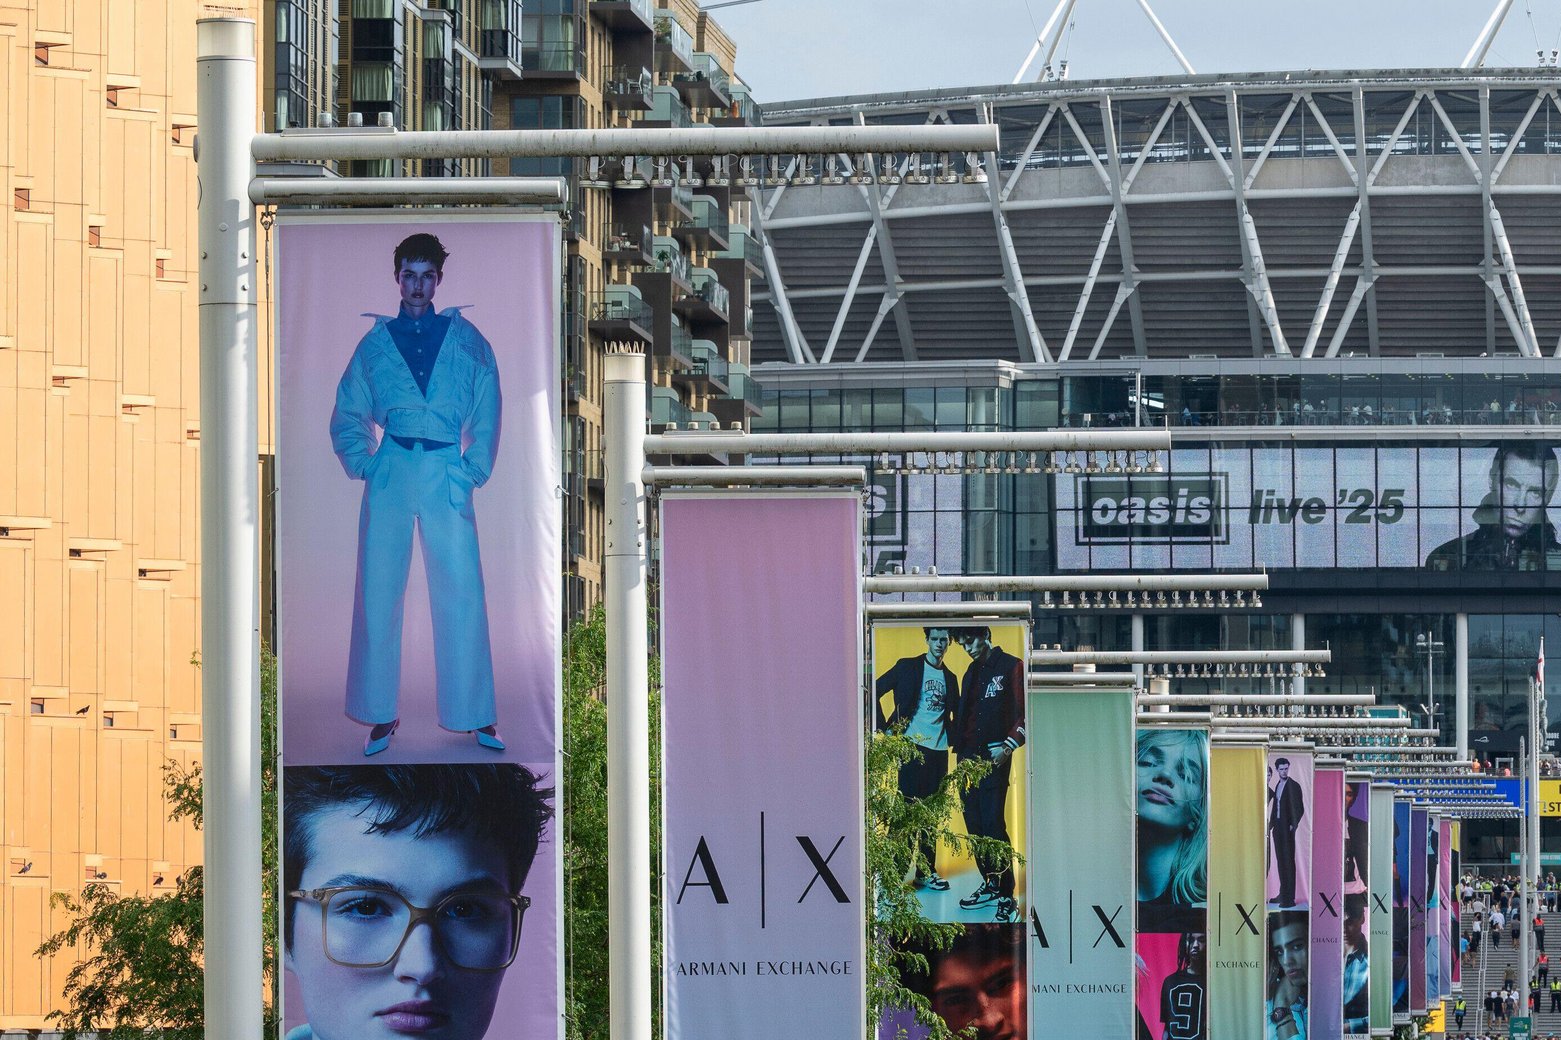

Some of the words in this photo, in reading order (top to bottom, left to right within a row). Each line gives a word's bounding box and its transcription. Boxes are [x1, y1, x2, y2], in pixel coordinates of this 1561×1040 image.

[1091, 488, 1213, 525] oasis
[1248, 489, 1326, 525] live
[677, 961, 746, 976] ARMANI
[756, 960, 853, 976] EXCHANGE
[1215, 961, 1260, 969] EXCHANGE
[1032, 984, 1060, 993] MANI
[1066, 984, 1127, 994] EXCHANGE
[1168, 983, 1203, 1040] 9
